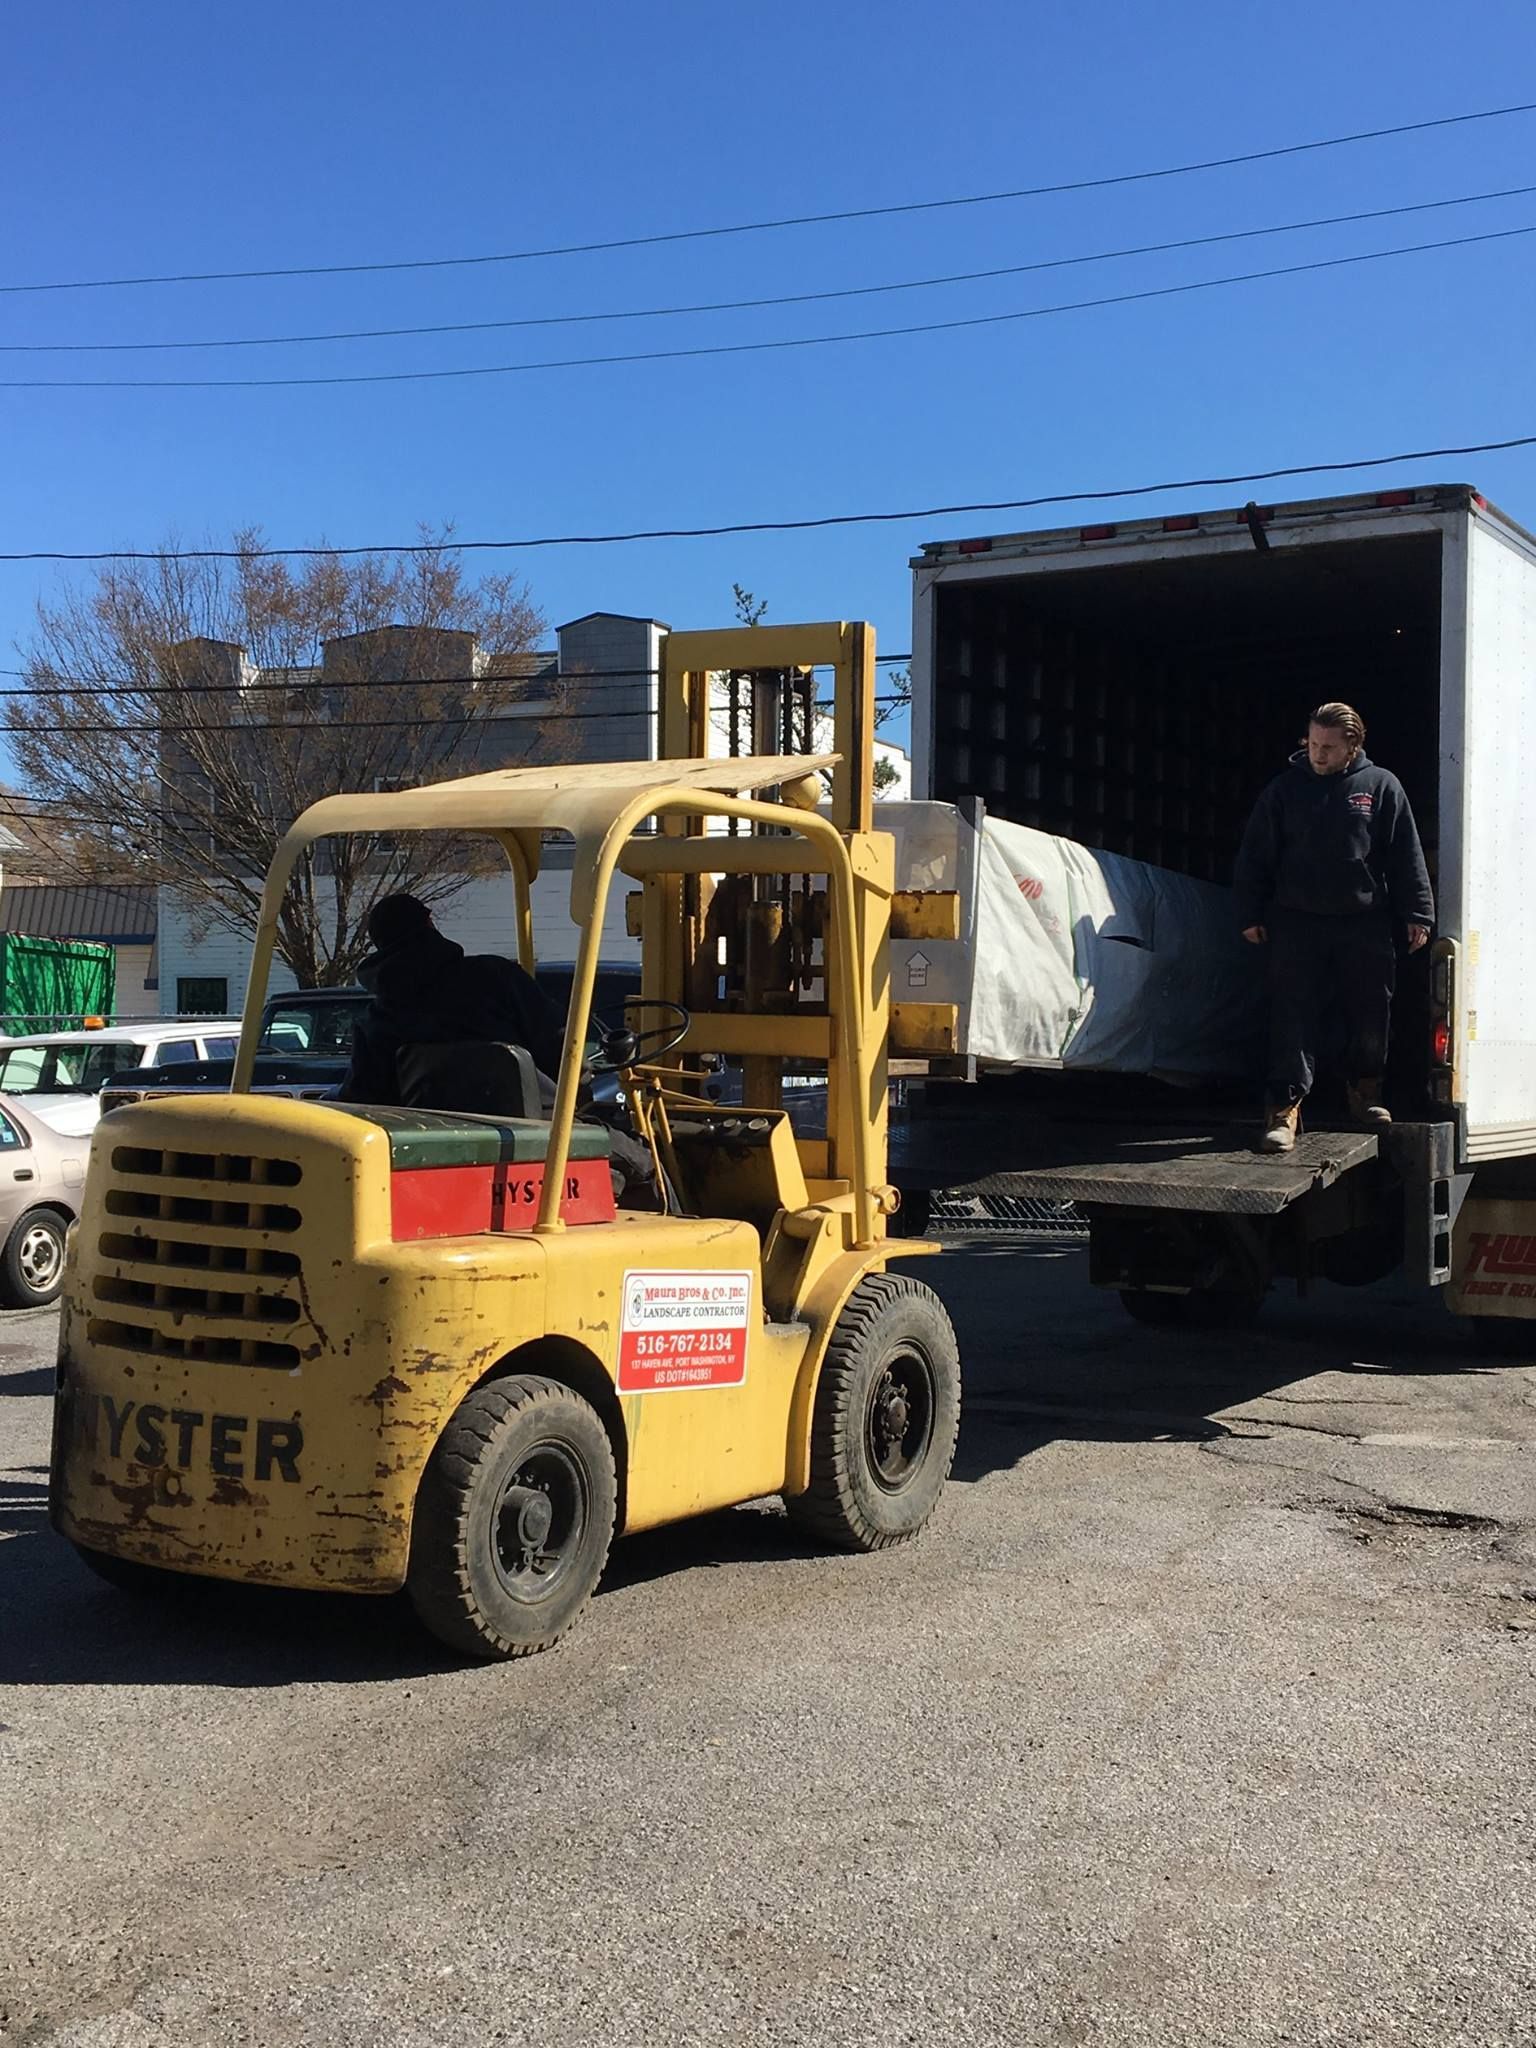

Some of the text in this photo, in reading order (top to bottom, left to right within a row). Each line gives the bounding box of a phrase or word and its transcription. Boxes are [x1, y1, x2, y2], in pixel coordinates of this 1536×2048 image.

[492, 1178, 579, 1206] HYSR
[644, 1287, 746, 1302] Maura Bros & Co. Inc.
[643, 1306, 745, 1318] LANDSCAPE CONTRACTOR
[637, 1333, 732, 1355] 516-767-2134
[655, 1371, 666, 1384] US
